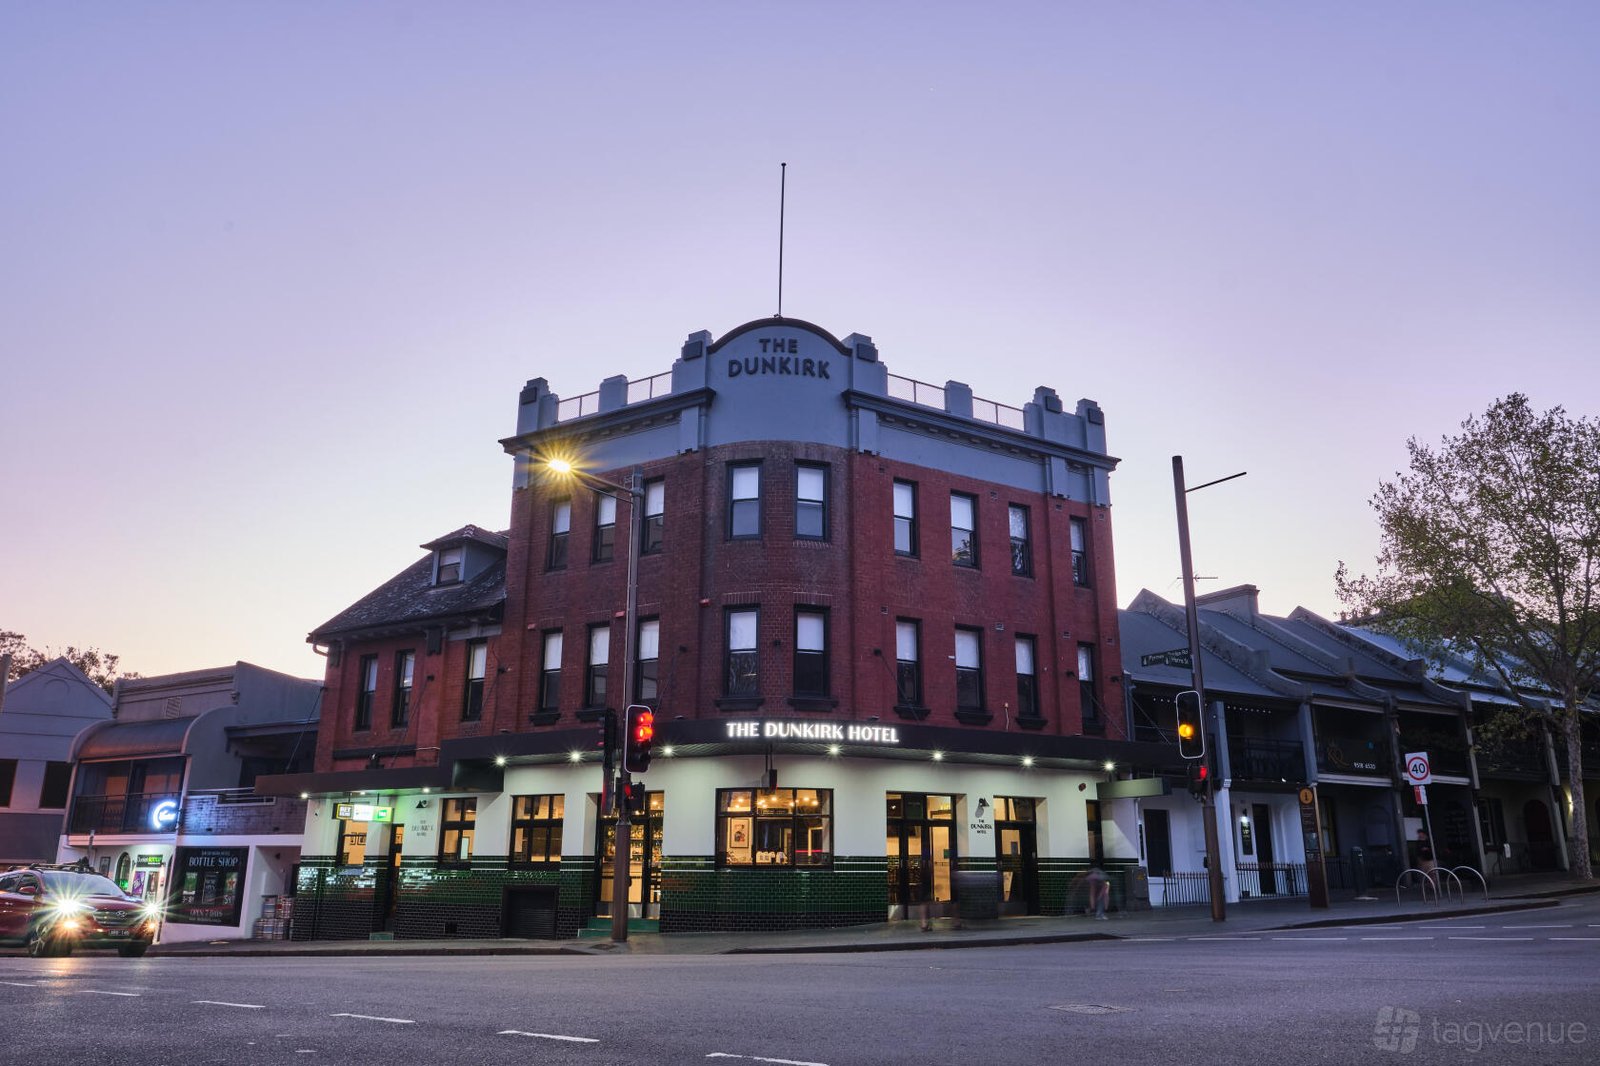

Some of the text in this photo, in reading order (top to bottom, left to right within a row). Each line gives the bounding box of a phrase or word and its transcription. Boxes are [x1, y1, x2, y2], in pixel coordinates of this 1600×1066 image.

[759, 338, 798, 354] THE
[728, 357, 830, 379] DUNKIRK
[726, 722, 900, 743] THE DUNKIRK HOTEL
[1412, 762, 1426, 774] 40
[189, 857, 239, 867] BOTTLE SHOP
